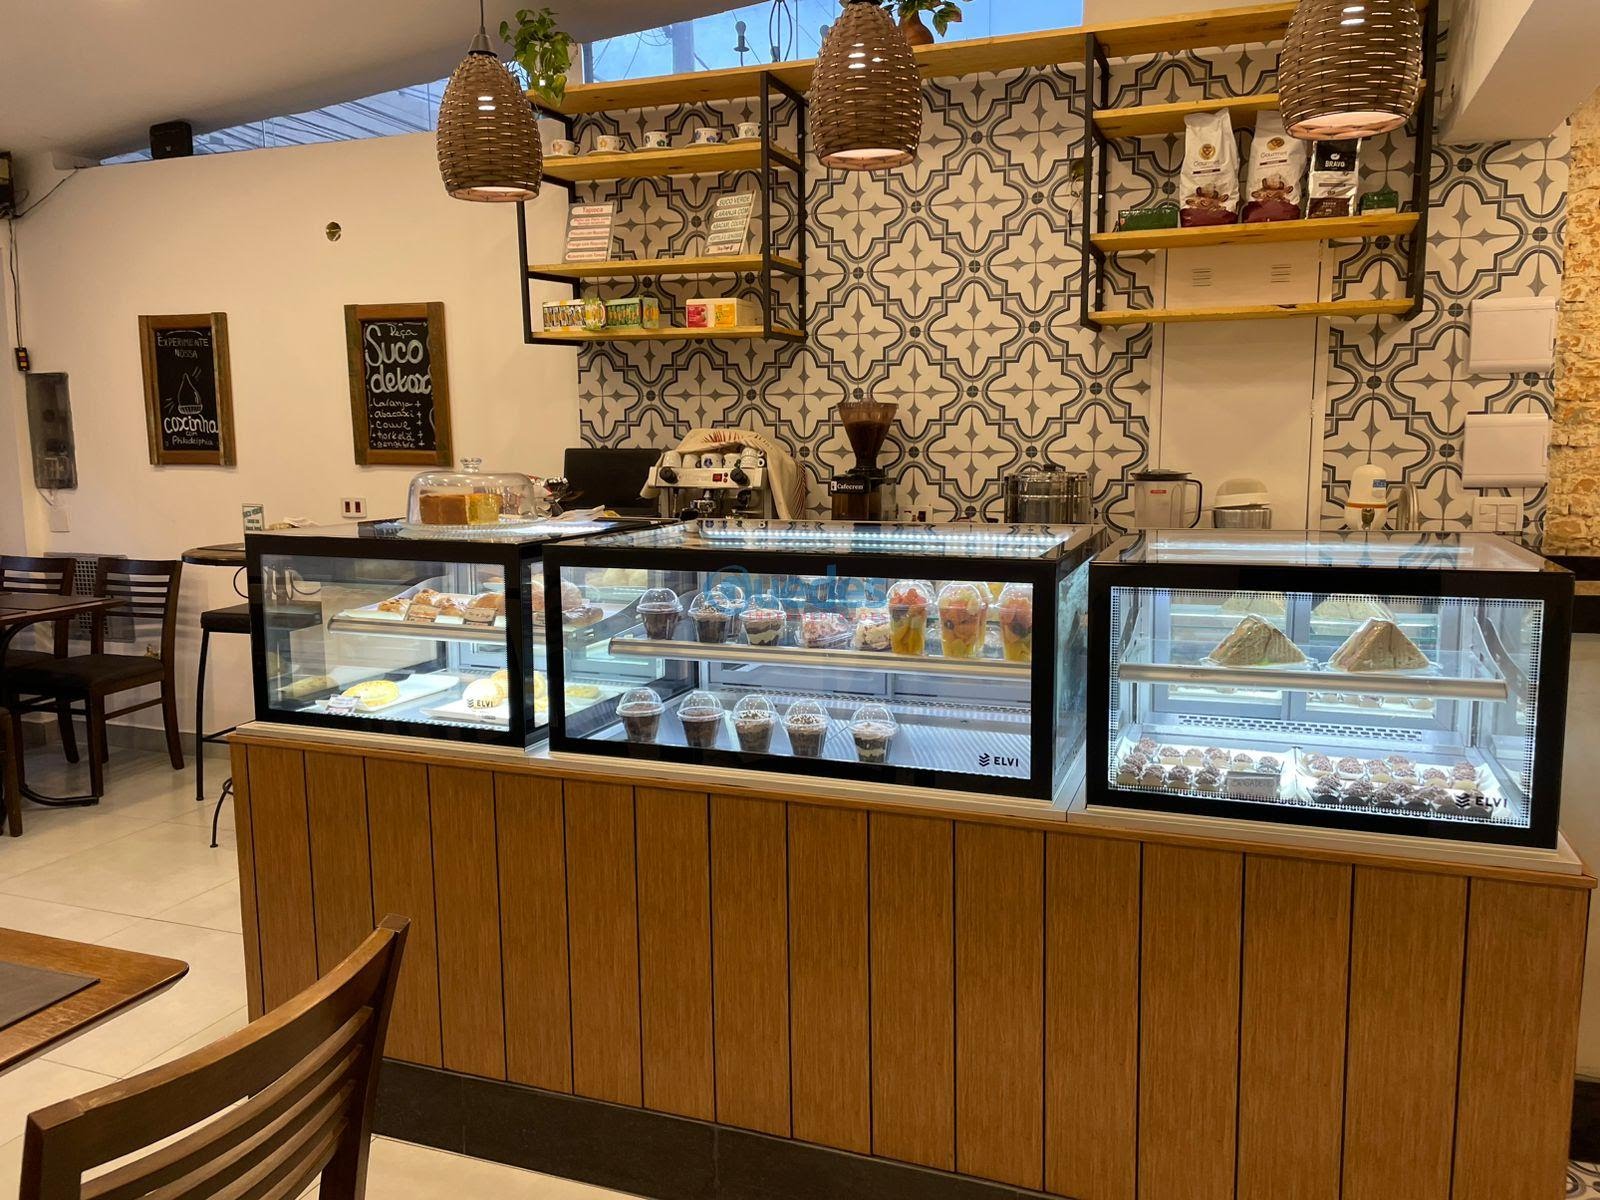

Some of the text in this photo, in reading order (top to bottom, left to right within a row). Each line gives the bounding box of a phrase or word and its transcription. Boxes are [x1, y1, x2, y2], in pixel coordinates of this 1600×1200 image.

[1325, 160, 1346, 168] BRAVO
[719, 195, 752, 206] SUCO VERDE
[582, 206, 604, 214] Tapioca
[715, 207, 749, 218] LARANJA COM
[157, 336, 209, 348] EXPERIMENTE
[365, 324, 424, 367] Suco
[174, 348, 198, 359] NOSSA
[370, 364, 432, 394] detox
[164, 413, 220, 434] coxinha
[477, 699, 494, 707] ELVI
[993, 756, 1019, 767] ELVI
[1475, 796, 1507, 808] ELVI
